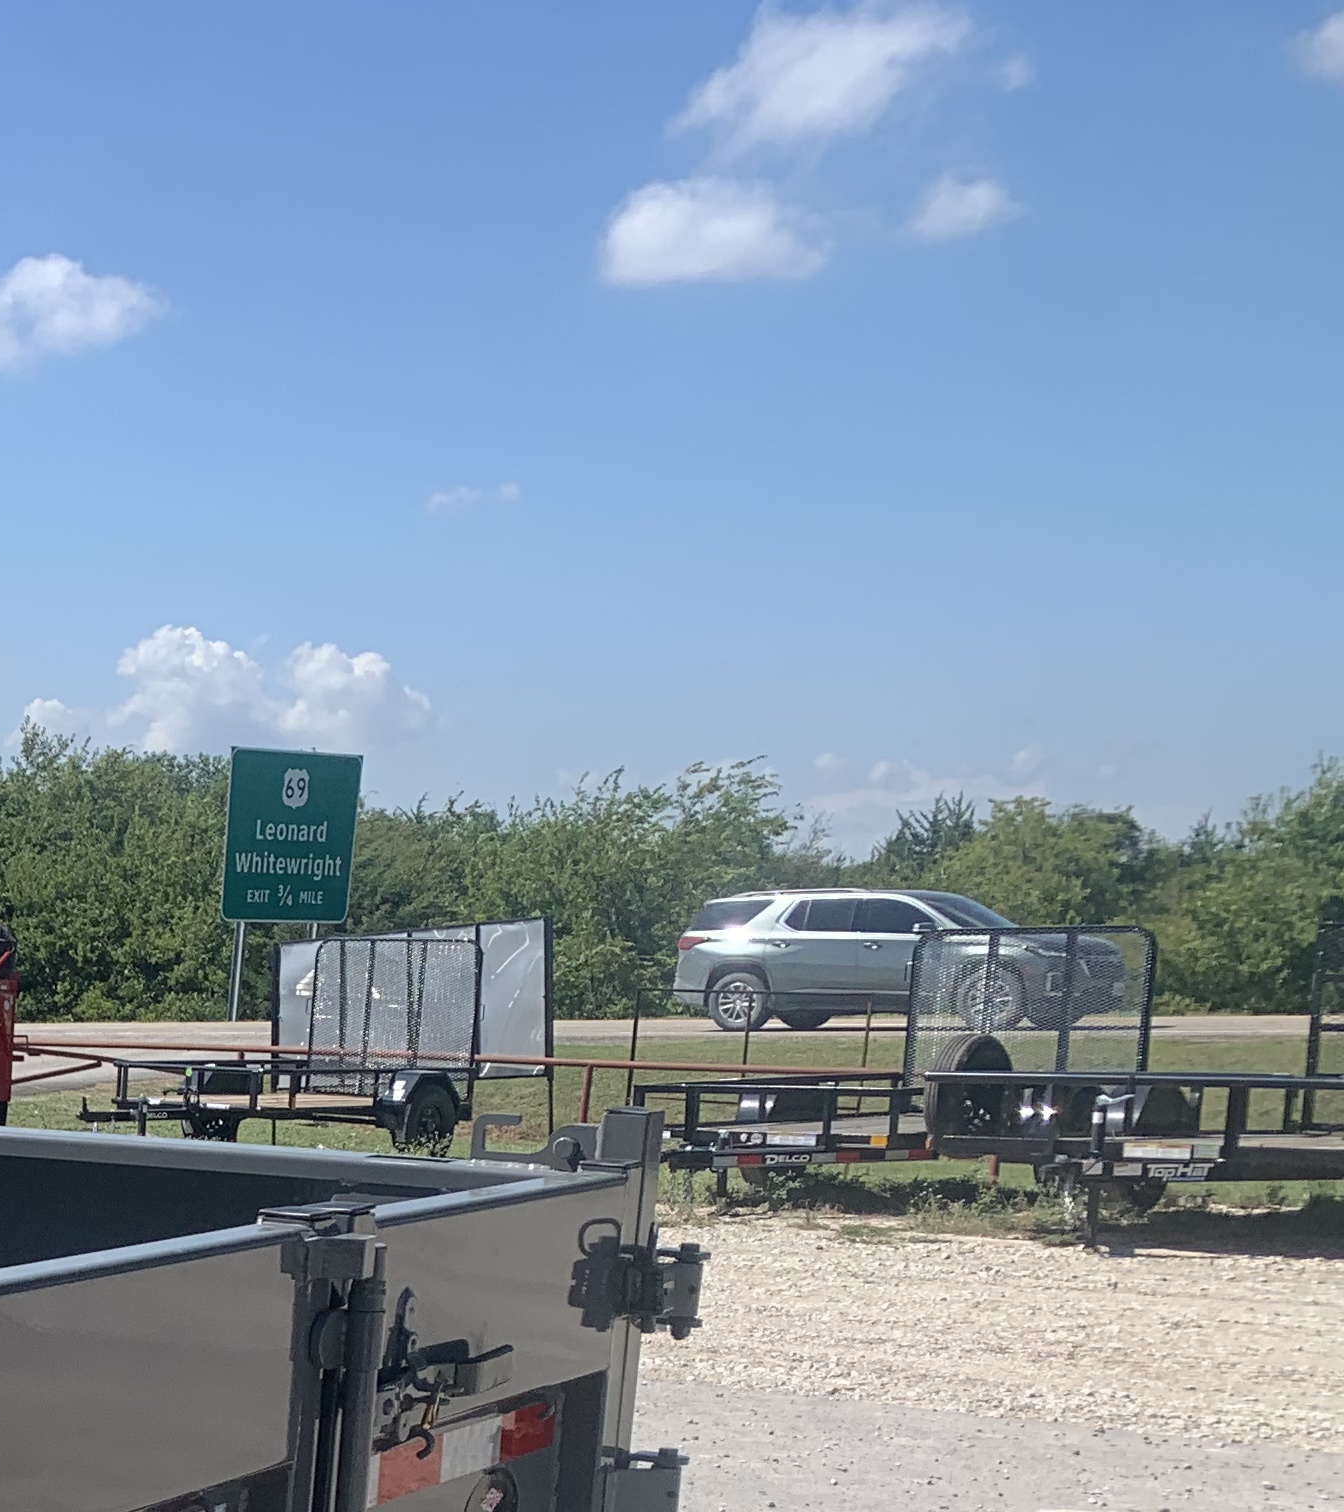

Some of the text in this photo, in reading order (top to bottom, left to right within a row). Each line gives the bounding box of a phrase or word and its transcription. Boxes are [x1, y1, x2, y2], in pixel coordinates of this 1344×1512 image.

[285, 777, 306, 799] 69
[256, 819, 328, 842] Leonard
[235, 852, 342, 881] Whitewright
[247, 889, 270, 903] EXIT
[299, 890, 323, 904] MILE
[765, 1154, 810, 1165] DELCO
